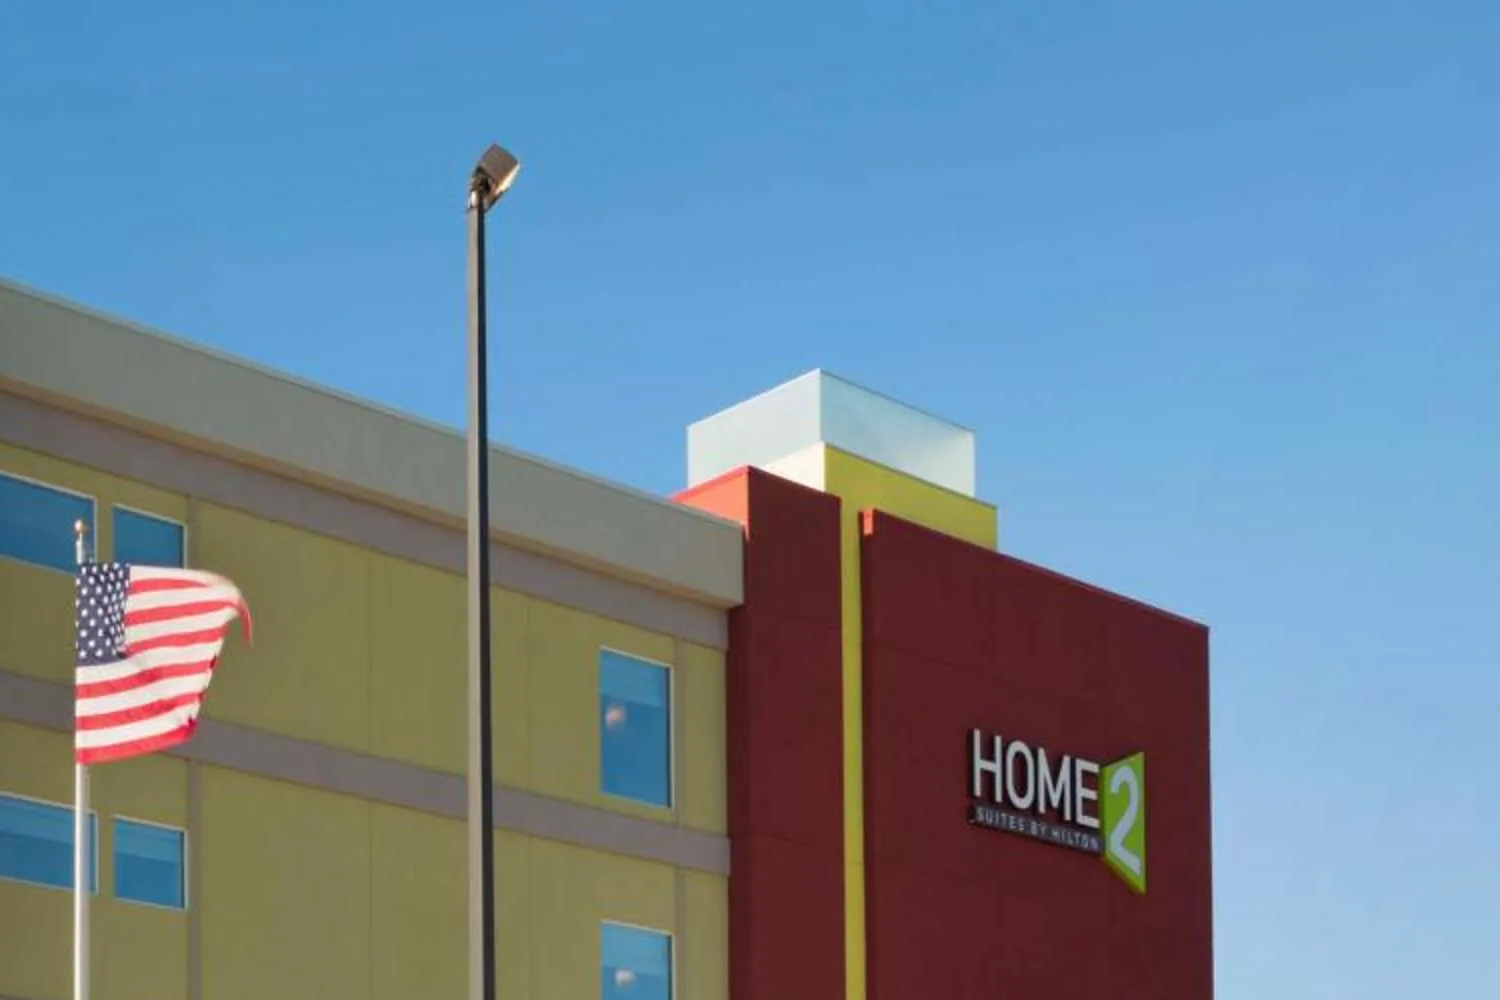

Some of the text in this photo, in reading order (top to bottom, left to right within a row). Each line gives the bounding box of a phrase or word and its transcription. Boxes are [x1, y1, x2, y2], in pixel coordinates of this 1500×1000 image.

[973, 728, 1141, 876] HOME 2
[976, 806, 1025, 832] SUITES
